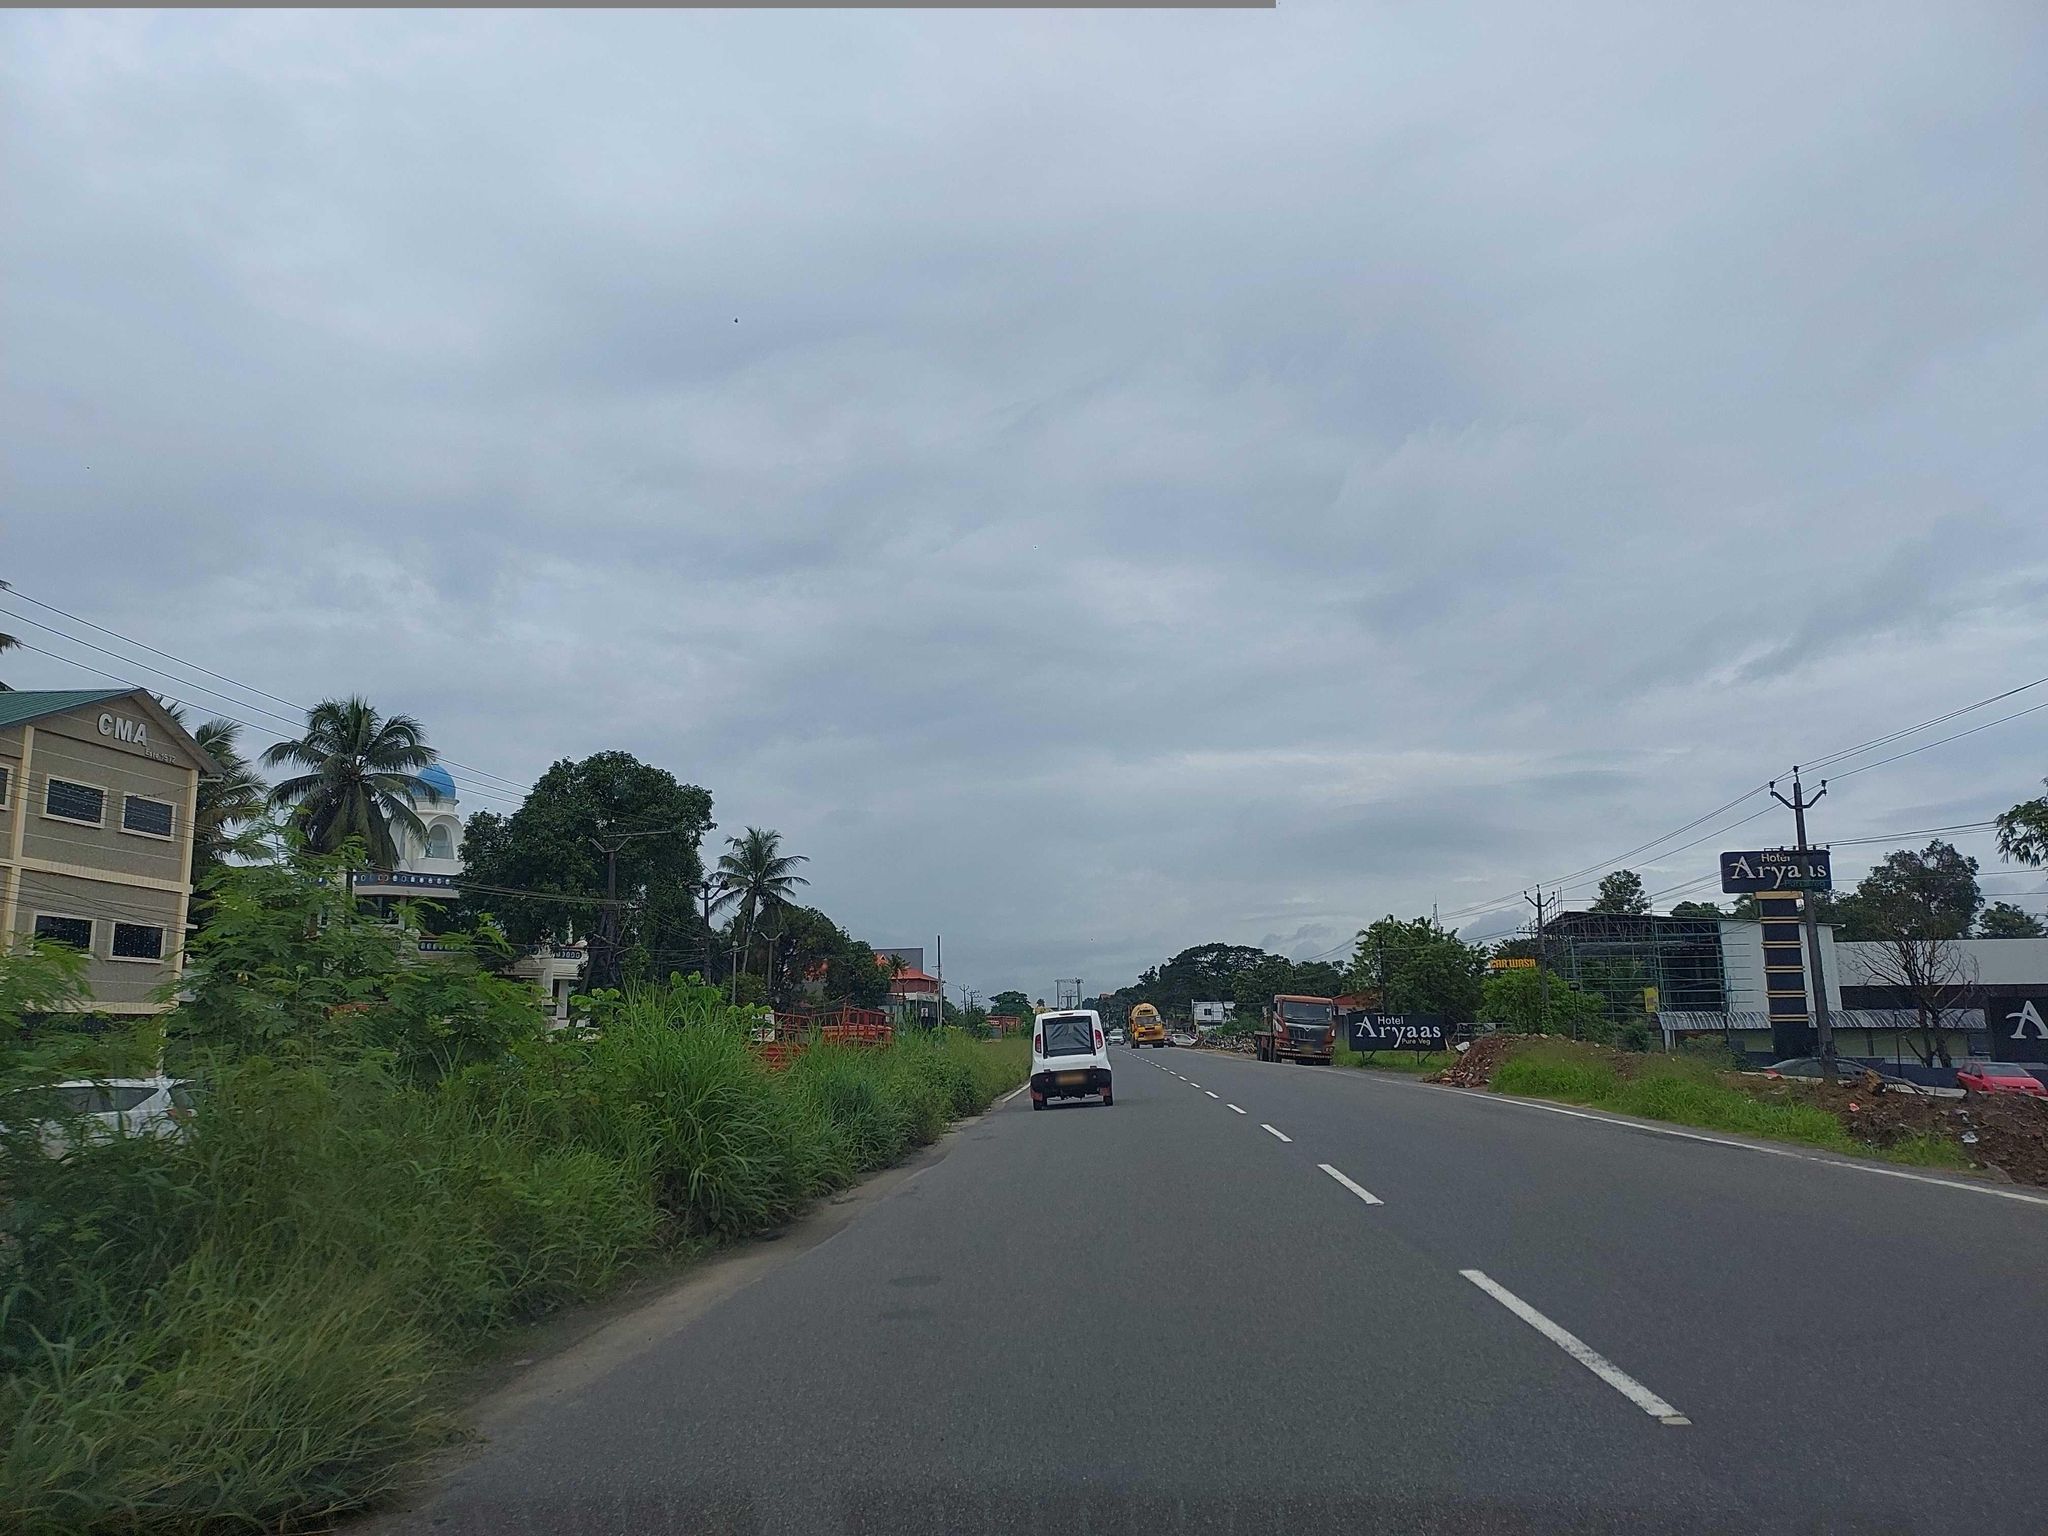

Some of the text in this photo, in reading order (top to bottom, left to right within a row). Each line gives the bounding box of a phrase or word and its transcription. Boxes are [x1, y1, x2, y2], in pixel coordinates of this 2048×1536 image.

[98, 713, 147, 747] CMA
[1509, 958, 1536, 968] WASH
[1377, 1016, 1404, 1025] Hotel
[1355, 1016, 1441, 1048] Aryaas
[1418, 1038, 1431, 1046] Veg
